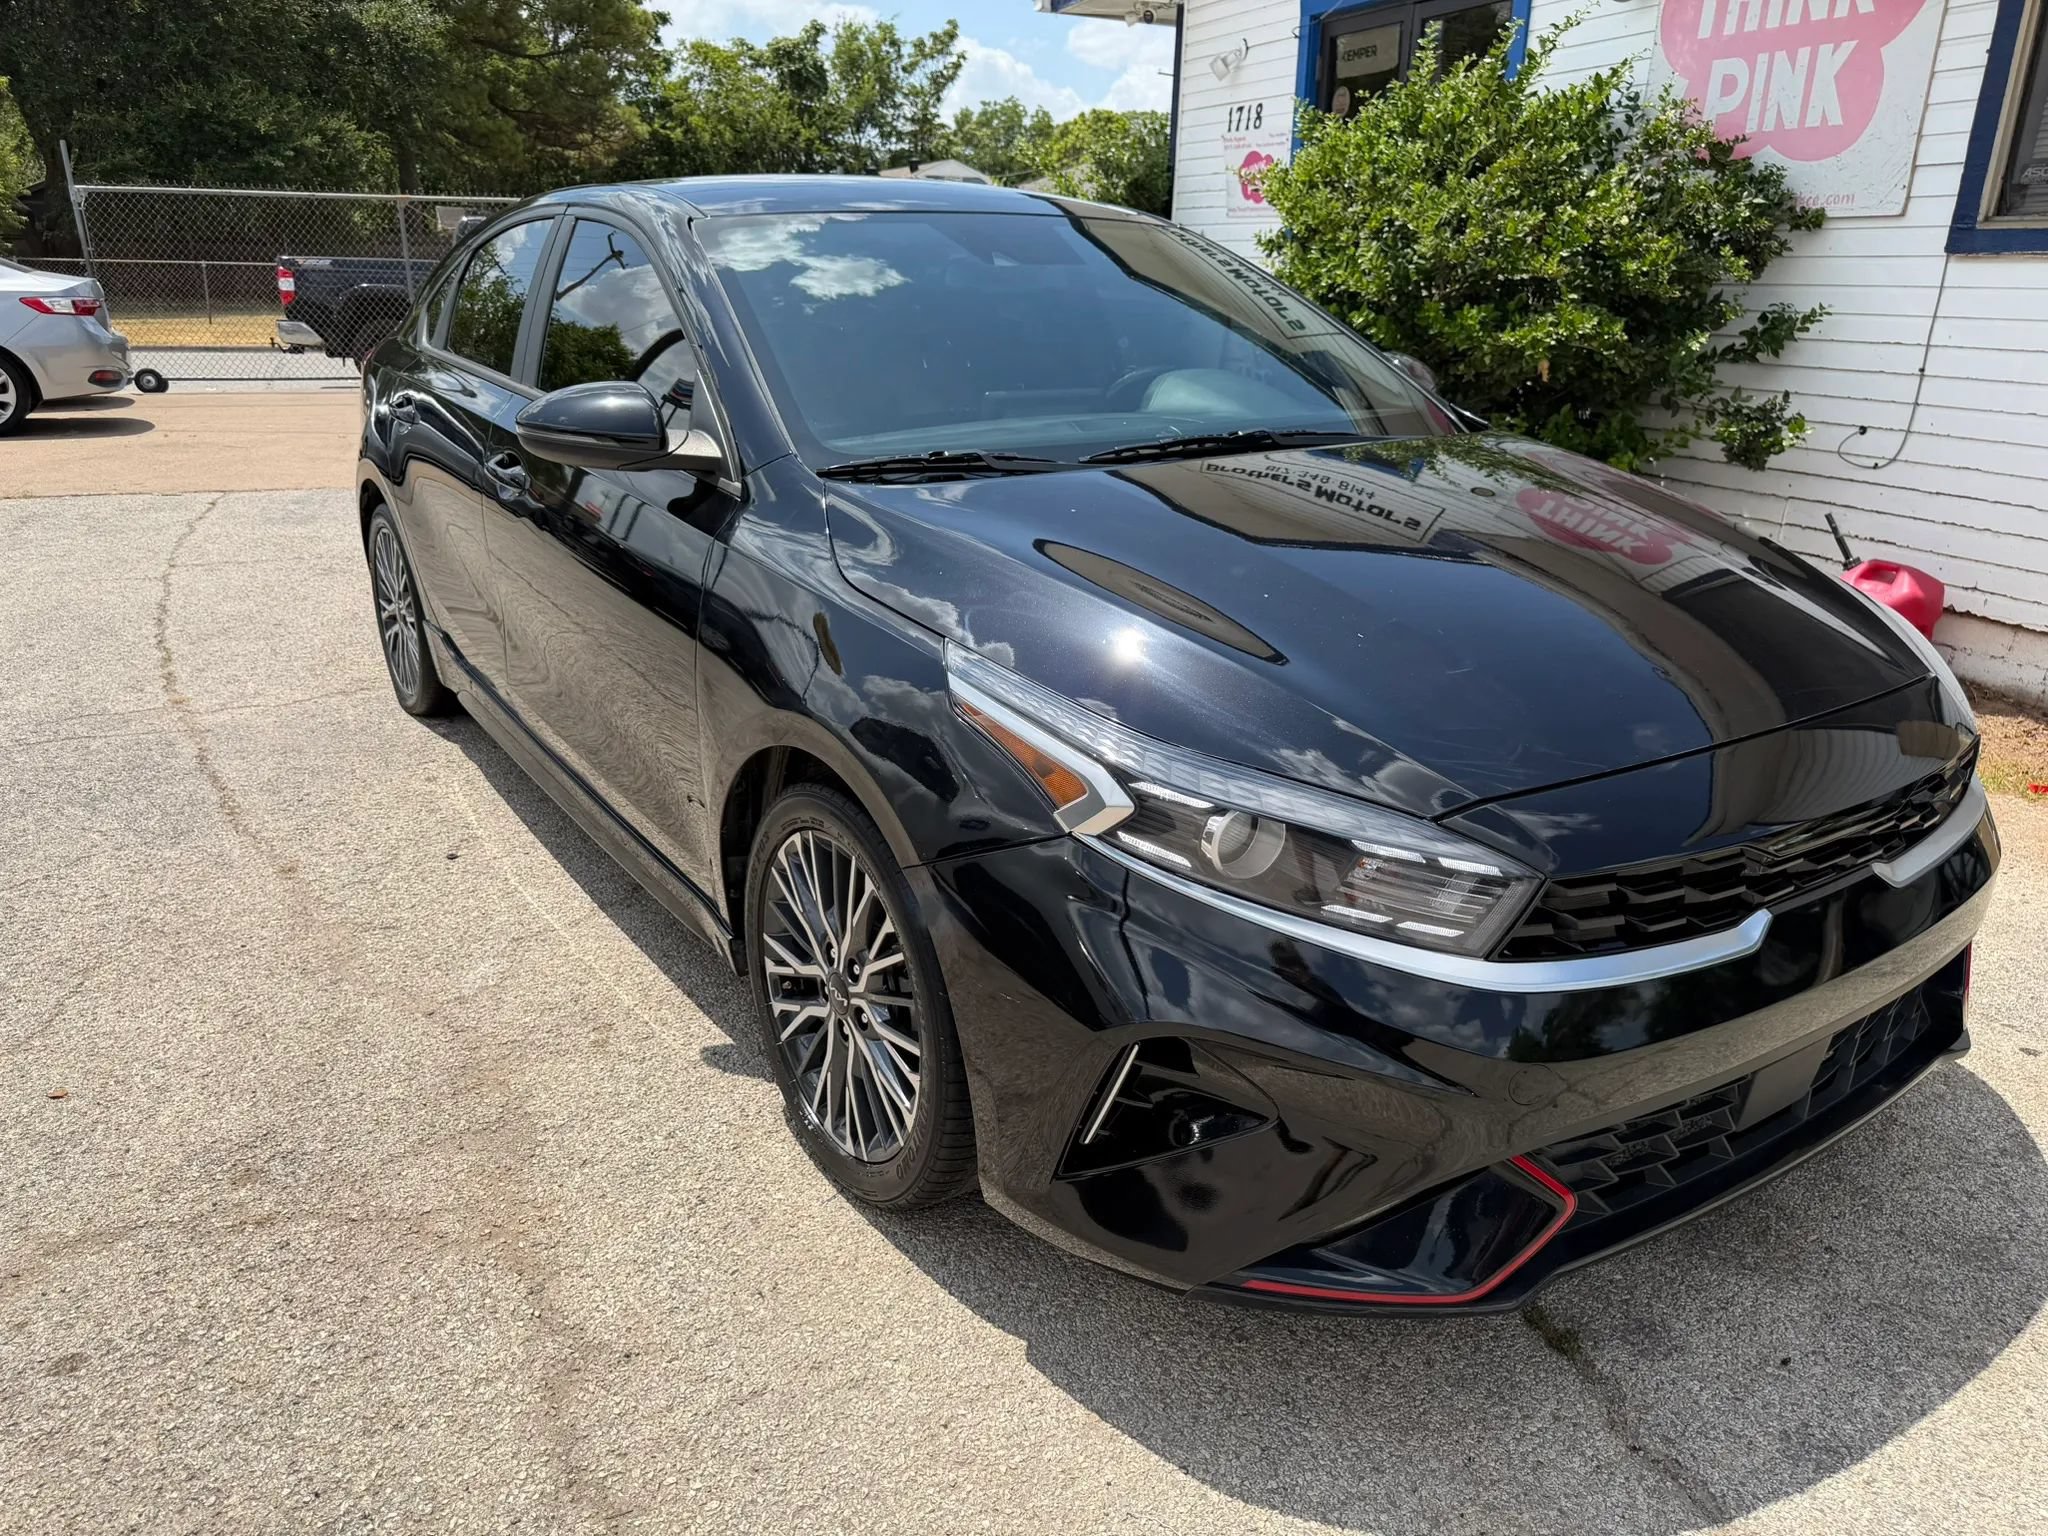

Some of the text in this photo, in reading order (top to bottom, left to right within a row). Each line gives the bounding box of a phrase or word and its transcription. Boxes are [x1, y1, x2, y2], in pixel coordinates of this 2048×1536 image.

[1343, 45, 1378, 62] KEMPER
[1703, 40, 1859, 133] PINK
[1227, 102, 1264, 133] 1718
